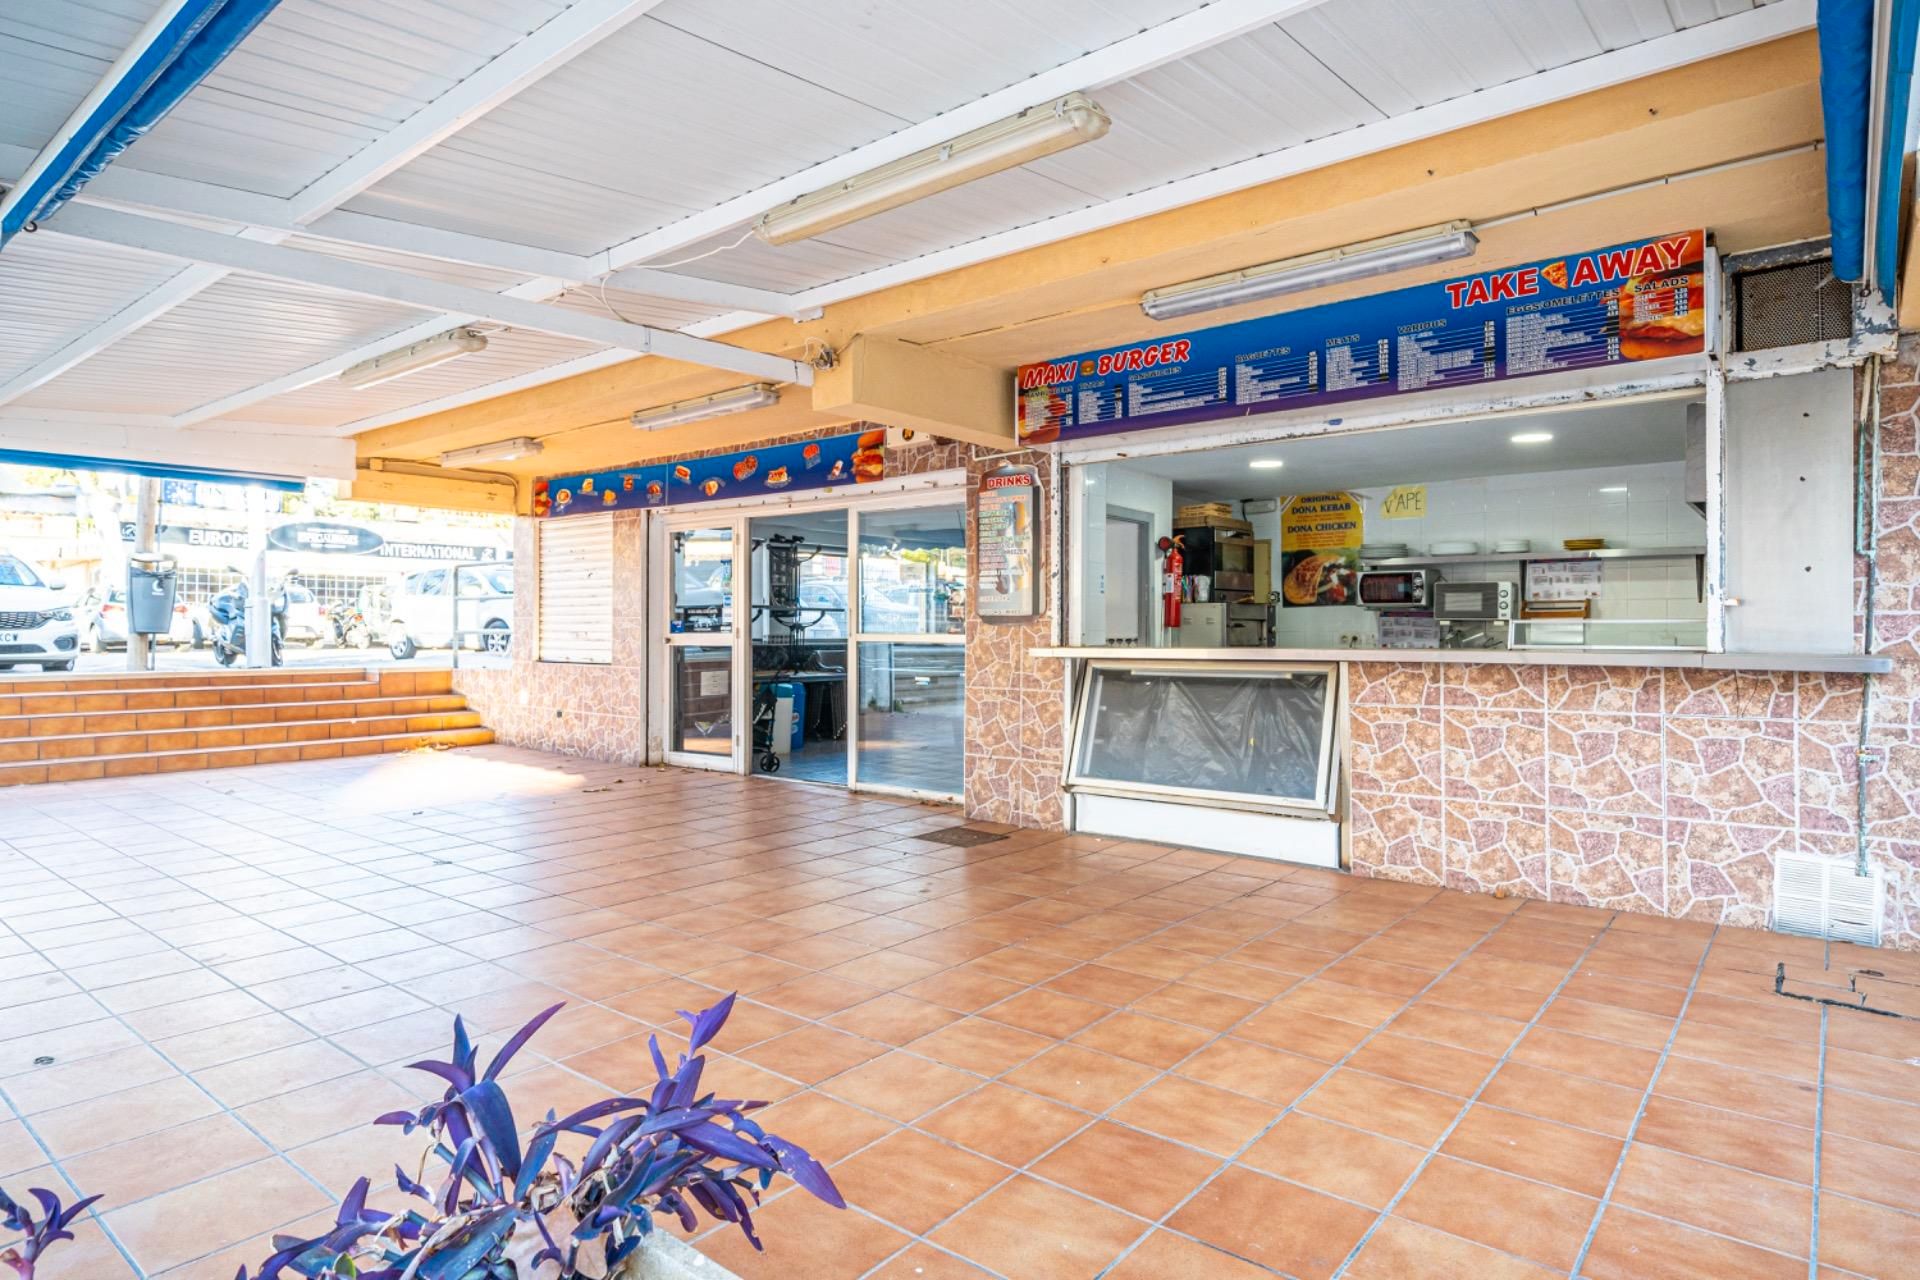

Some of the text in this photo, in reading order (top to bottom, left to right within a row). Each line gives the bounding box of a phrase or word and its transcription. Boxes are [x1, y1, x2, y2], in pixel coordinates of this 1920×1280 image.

[1446, 237, 1691, 309] TAKE AWAY
[1634, 275, 1688, 292] SALADS
[1397, 318, 1447, 334] VARIOUS
[1023, 339, 1191, 389] MAXI BURGER
[987, 474, 1031, 490] DRINKS
[1301, 494, 1341, 504] ORIGINAL
[1292, 502, 1351, 515] DONA KEBAB
[1287, 521, 1357, 534] DONA CHICKEN
[380, 542, 476, 560] INTERNATIONAL
